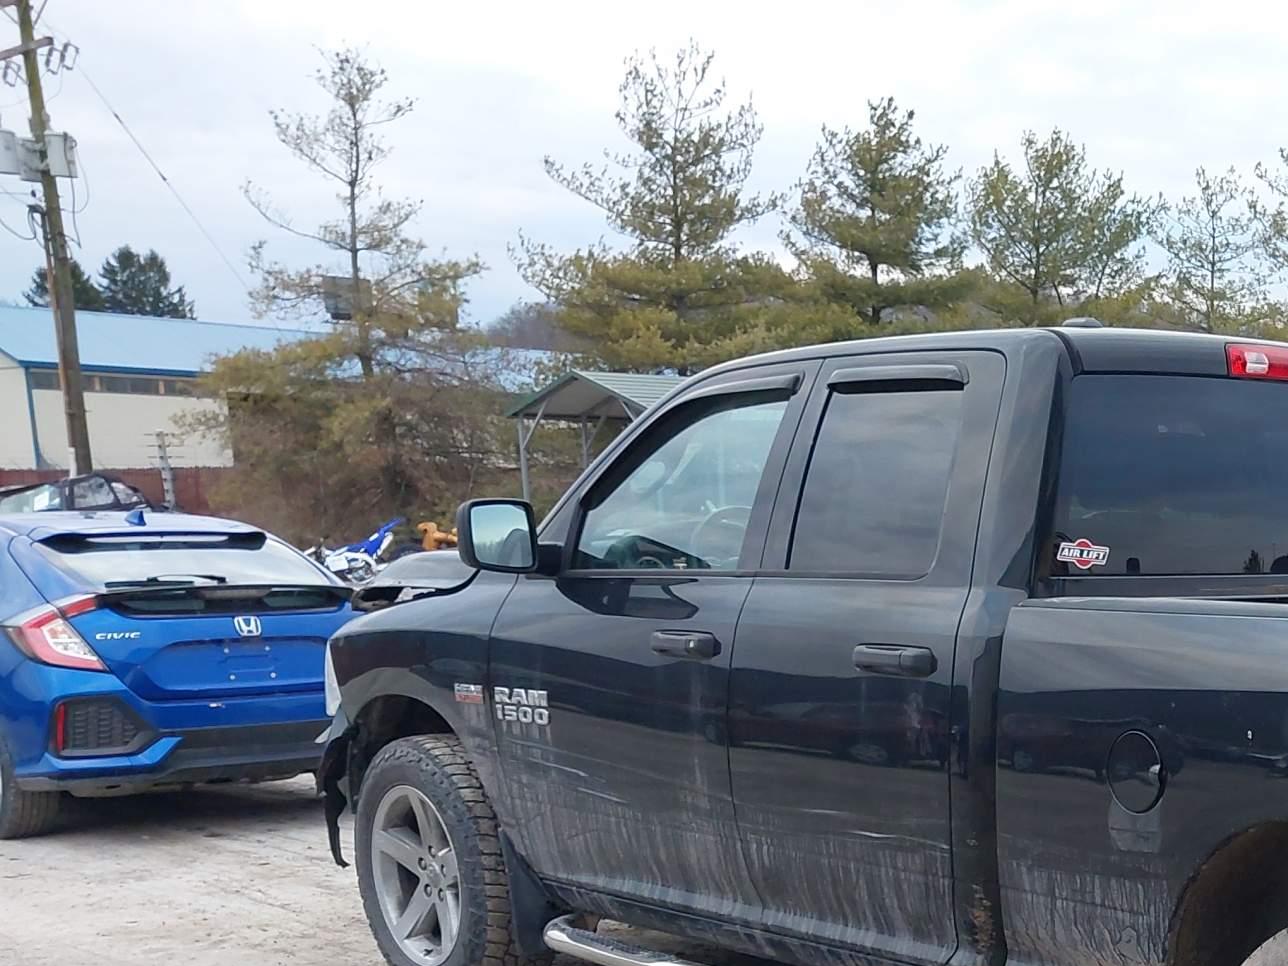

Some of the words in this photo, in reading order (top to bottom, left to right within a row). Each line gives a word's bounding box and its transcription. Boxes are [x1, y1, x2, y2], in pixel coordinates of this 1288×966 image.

[1061, 547, 1080, 558] AIR
[1082, 549, 1105, 560] LIFT
[95, 631, 141, 640] CIVIC
[493, 686, 548, 707] RAM
[495, 703, 549, 725] 1500
